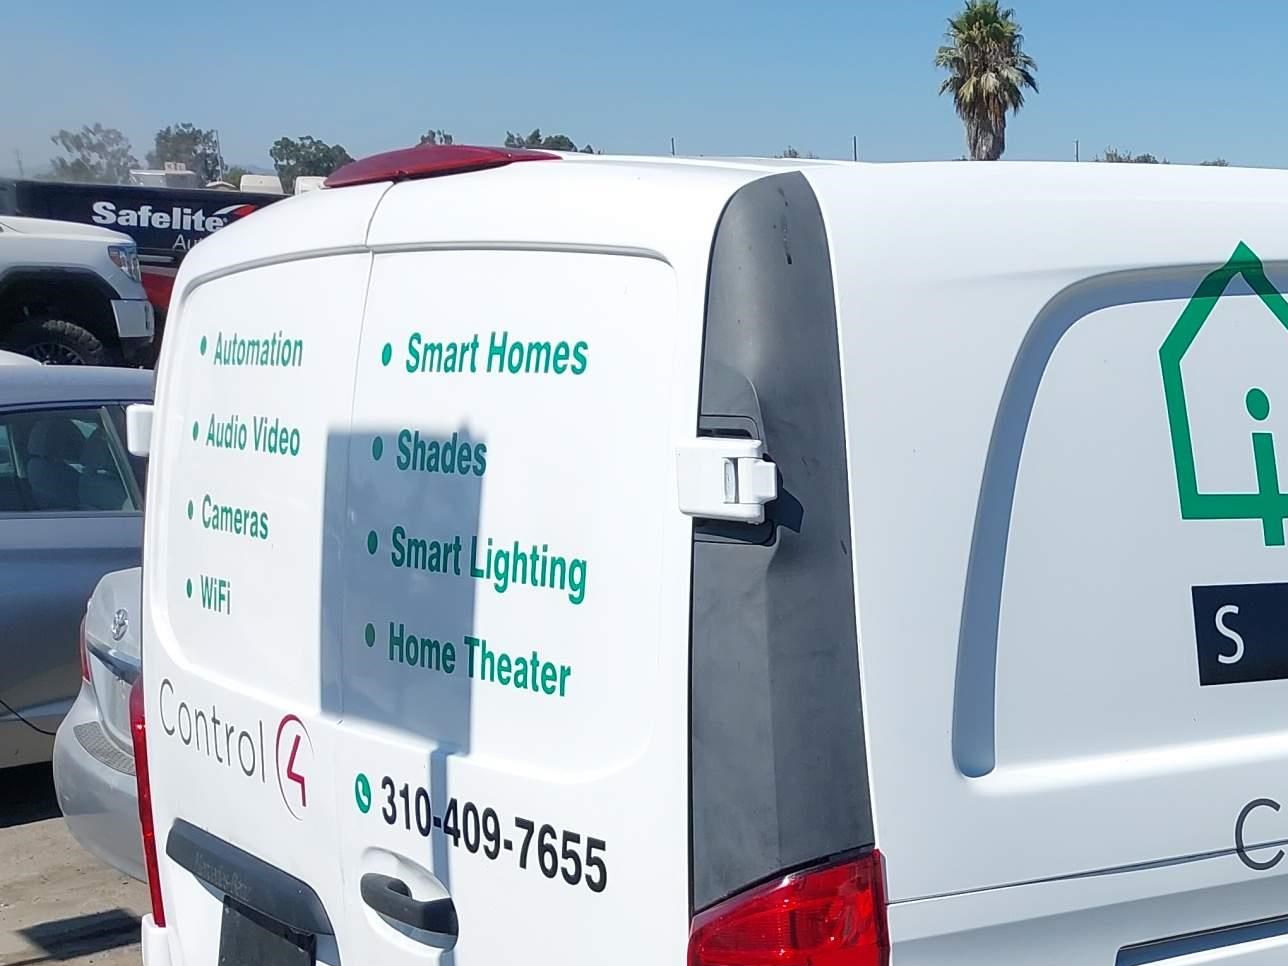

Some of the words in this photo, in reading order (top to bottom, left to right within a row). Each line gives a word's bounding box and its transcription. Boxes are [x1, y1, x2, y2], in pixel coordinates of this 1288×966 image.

[91, 201, 224, 232] Safelite
[213, 330, 303, 367] Automation
[405, 332, 478, 374] Smart
[486, 331, 589, 376] Homes
[205, 413, 247, 451] Audio
[252, 415, 301, 457] Video
[396, 428, 487, 477] Shades
[202, 496, 269, 540] Cameras
[390, 527, 462, 576] Smart
[470, 534, 587, 603] Lighting
[200, 575, 231, 615] WiFi
[388, 621, 456, 675] Home
[463, 634, 572, 698] Theater
[380, 775, 608, 893] 310-409-7655
